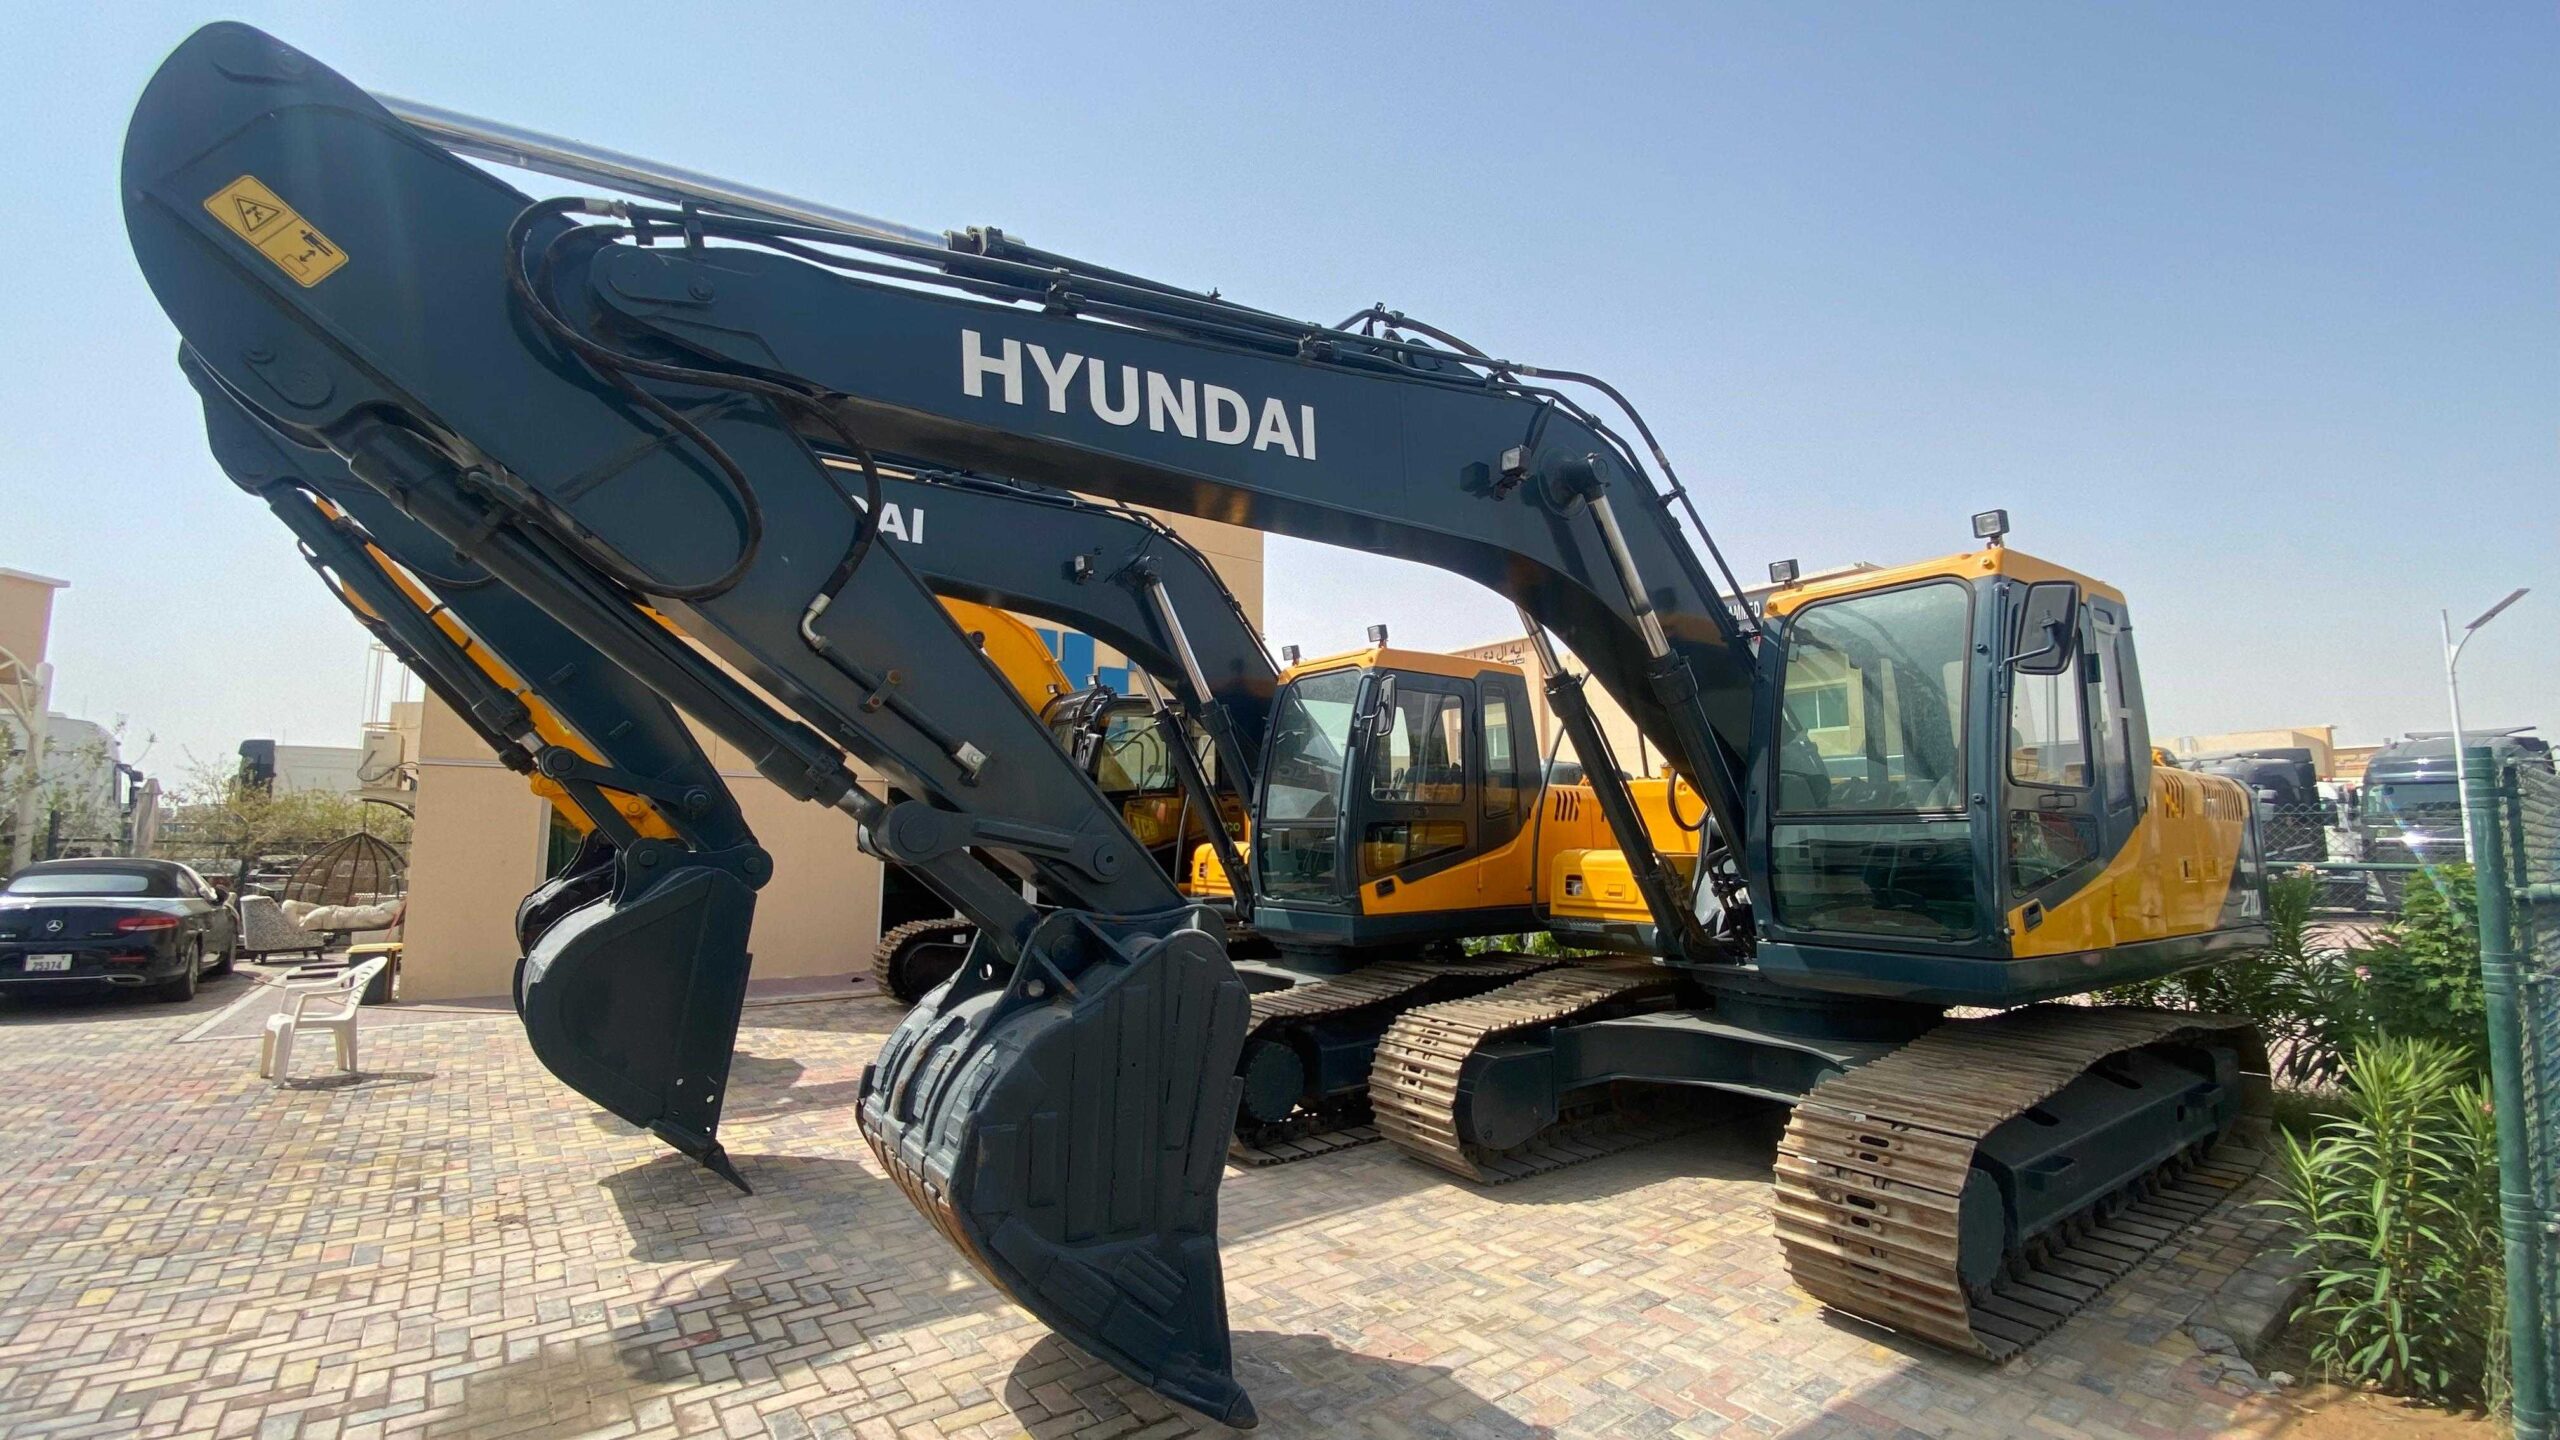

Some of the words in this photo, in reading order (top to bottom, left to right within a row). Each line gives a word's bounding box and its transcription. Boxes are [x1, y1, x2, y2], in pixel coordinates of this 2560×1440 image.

[962, 329, 1316, 460] HYUNDAI
[852, 494, 924, 544] AI
[1132, 815, 1159, 840] JCB
[2241, 889, 2260, 916] 210
[32, 961, 62, 971] 25374
